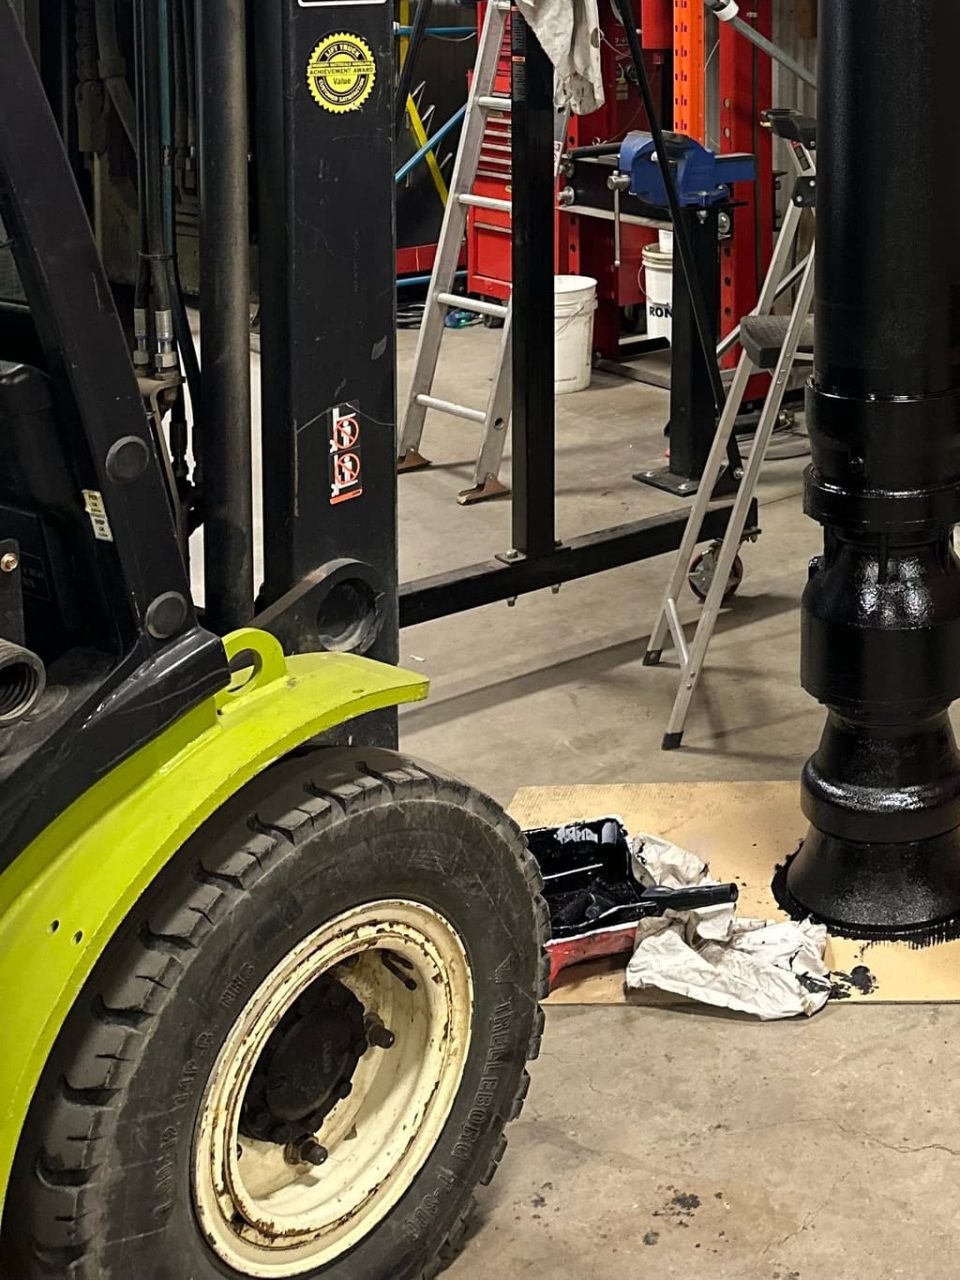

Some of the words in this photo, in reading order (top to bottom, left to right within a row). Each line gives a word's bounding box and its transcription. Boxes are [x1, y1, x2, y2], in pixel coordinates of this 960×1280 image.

[324, 45, 338, 57] LIFT
[340, 44, 360, 57] TRUCK
[333, 77, 352, 85] Value
[453, 998, 514, 1162] TRELLEBORG
